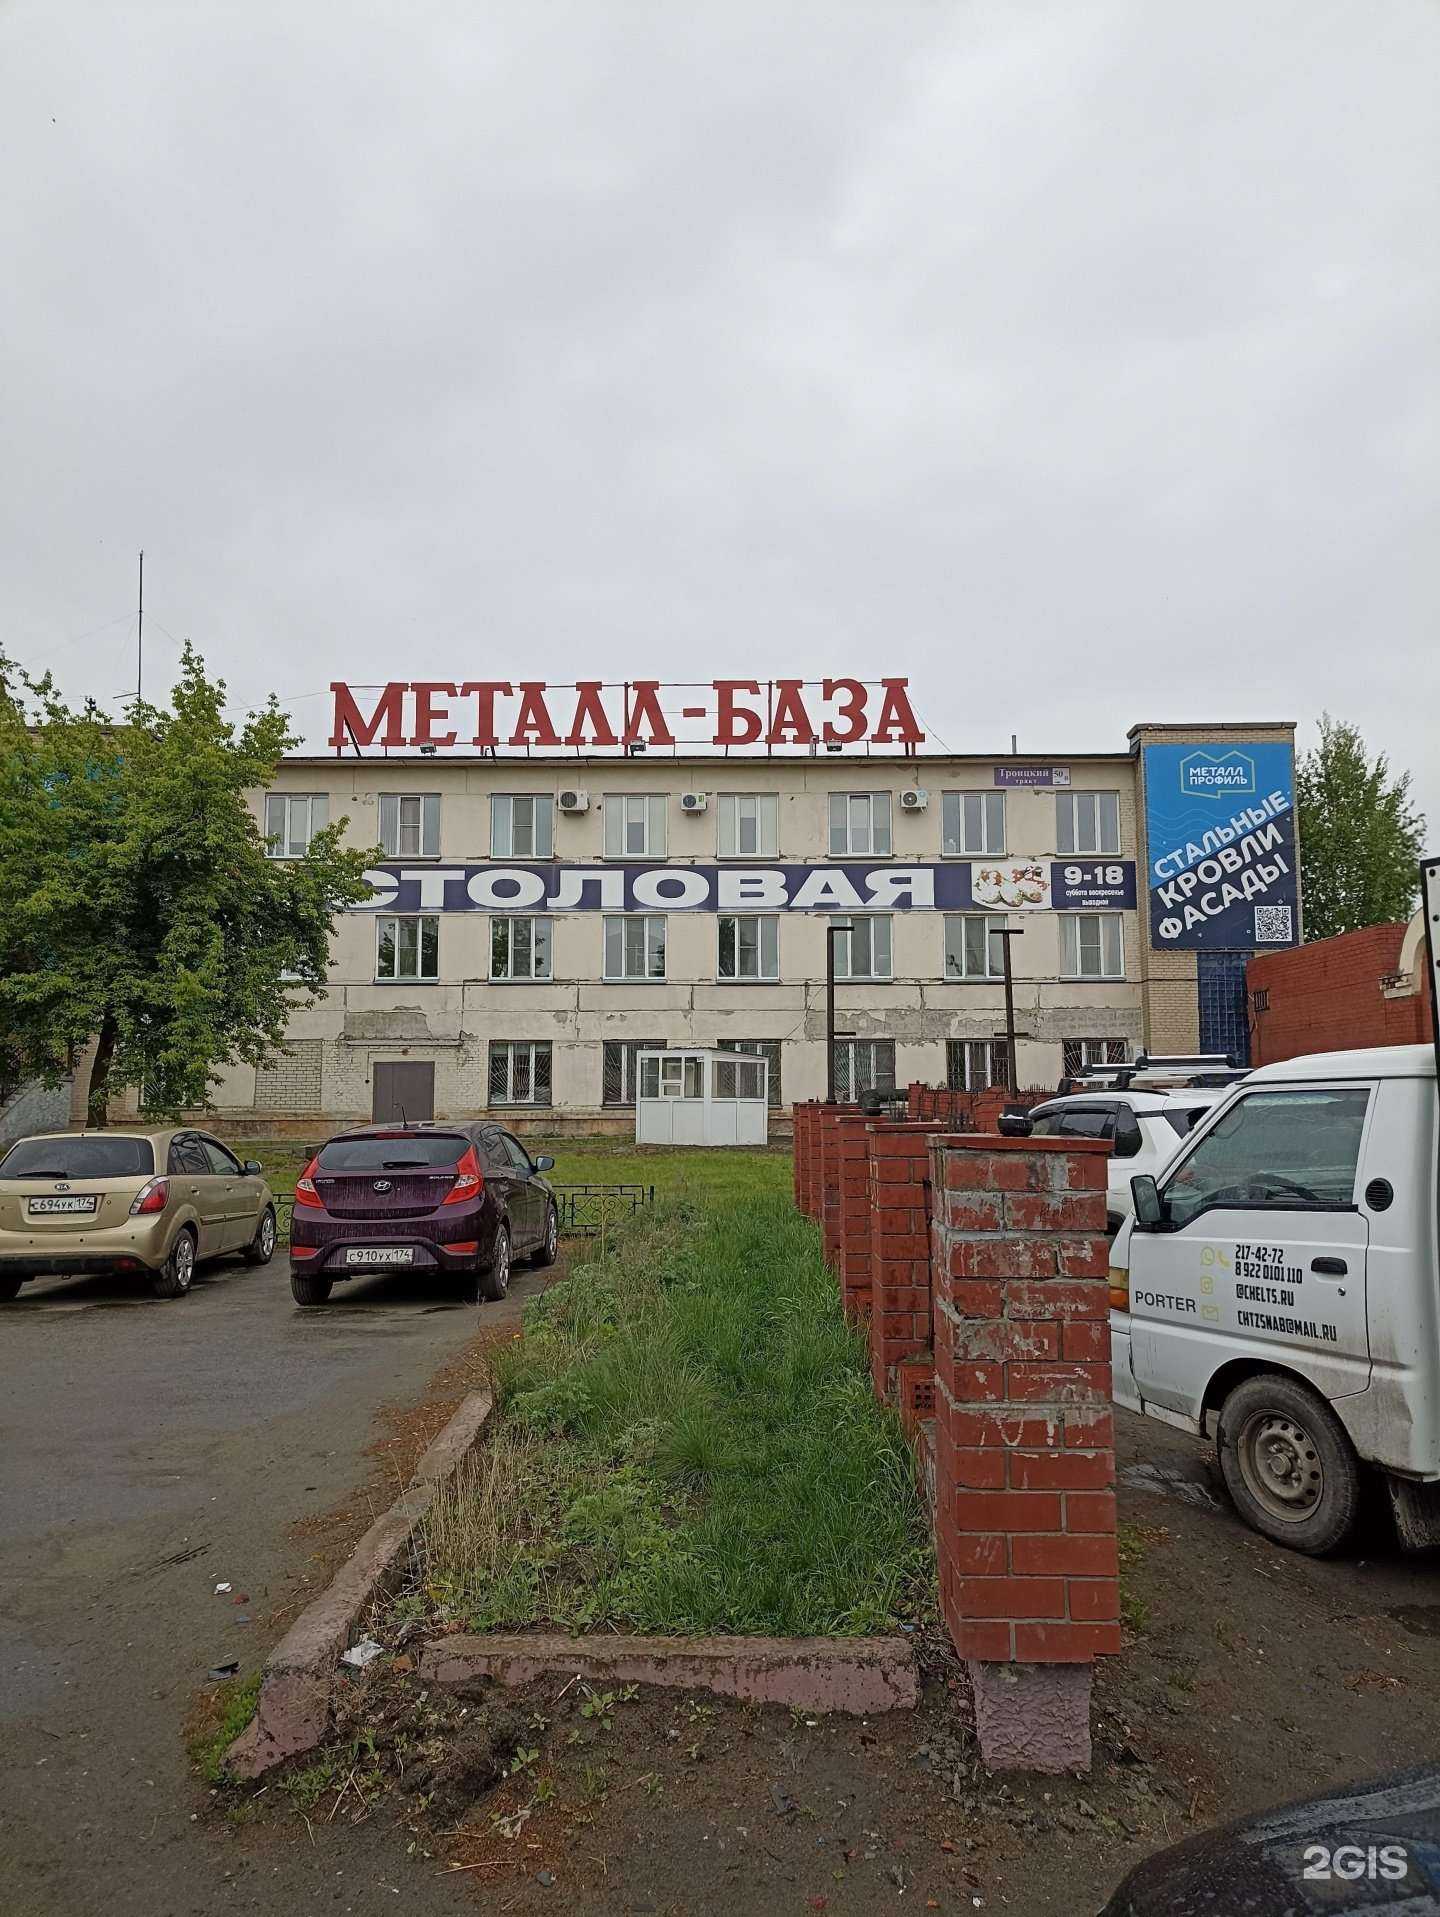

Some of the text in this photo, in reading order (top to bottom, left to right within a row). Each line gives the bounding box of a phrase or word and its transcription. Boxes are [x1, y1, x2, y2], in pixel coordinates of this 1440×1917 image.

[328, 677, 925, 747] МЕТАЛЛ-БАЗА
[999, 768, 1049, 779] Троицкий
[1189, 766, 1243, 777] МЕТАЛЛ
[1189, 776, 1248, 785] ПРОФИЛЬ
[1154, 790, 1290, 878] СТАЛЬНЫЕ
[1064, 866, 1124, 885] 9-18
[1157, 822, 1284, 909] КРОВЛИ
[331, 868, 935, 908] СТОЛОВАЯ
[1158, 853, 1290, 939] ФАСАДЫ
[1235, 1244, 1284, 1264] 217-42-72
[1235, 1261, 1303, 1284] 8 922 0101 110
[1135, 1290, 1197, 1312] PORTER
[1236, 1284, 1295, 1306] @CHELTS.RU
[1237, 1310, 1338, 1342] CHTZSNAB@MAIL.RU
